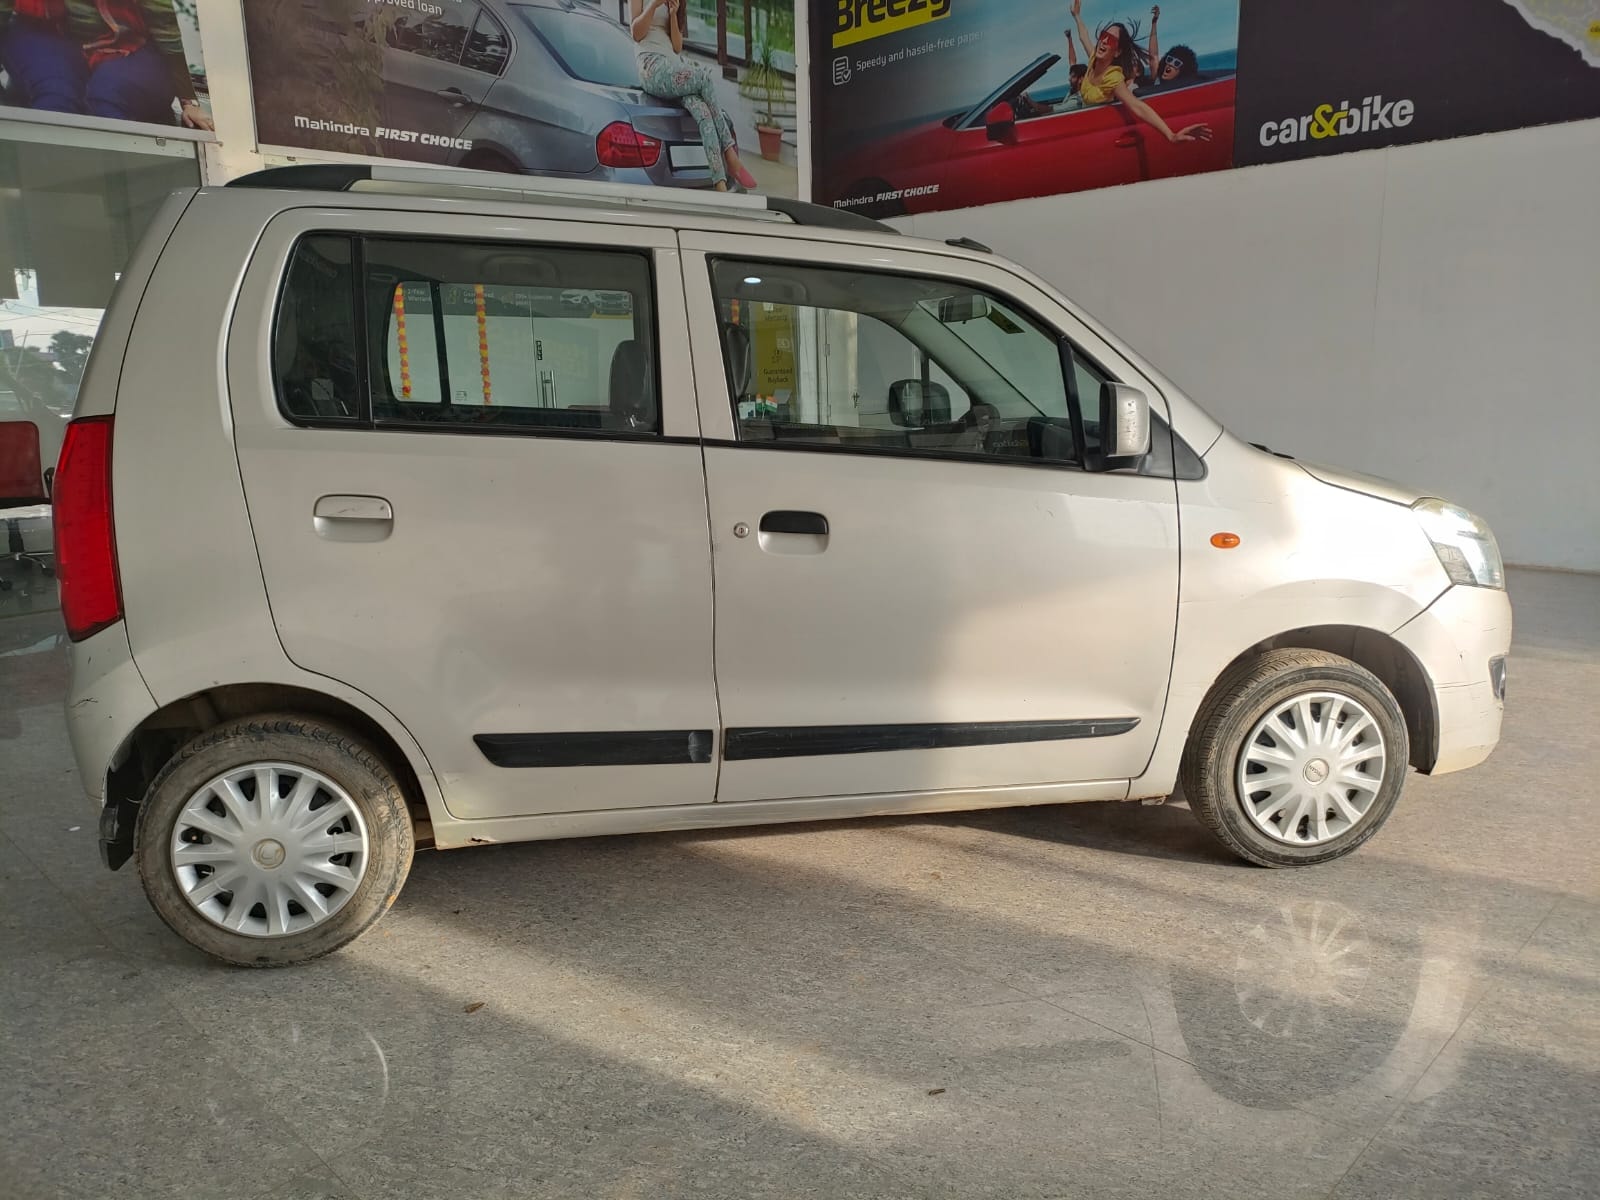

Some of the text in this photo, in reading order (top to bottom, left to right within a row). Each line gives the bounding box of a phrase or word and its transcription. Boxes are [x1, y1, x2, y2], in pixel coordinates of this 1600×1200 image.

[418, 1, 442, 15] loan
[856, 55, 887, 71] Speedy
[888, 50, 904, 63] and
[906, 37, 955, 58] hassle-free
[294, 115, 473, 150] Mahindra FIRST CHOICE
[1259, 95, 1415, 147] car&bike
[833, 184, 940, 209] Mahindra FIRST CHOICE
